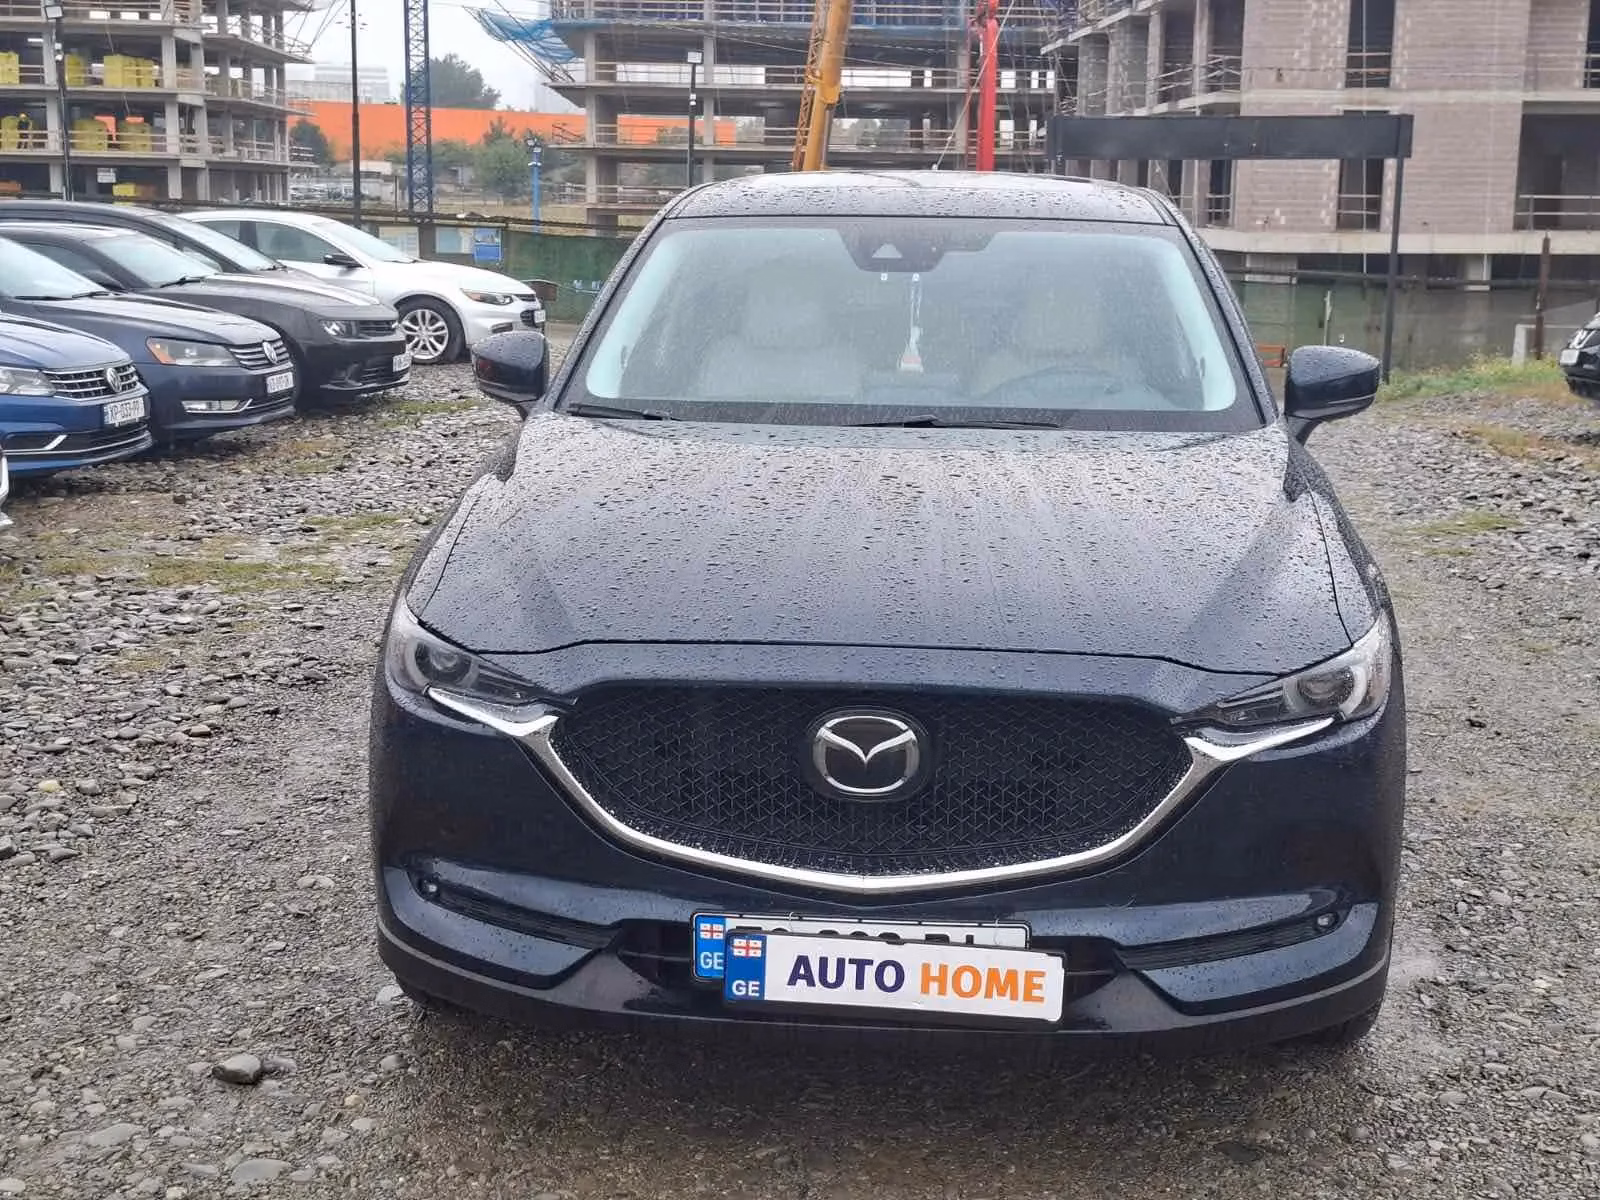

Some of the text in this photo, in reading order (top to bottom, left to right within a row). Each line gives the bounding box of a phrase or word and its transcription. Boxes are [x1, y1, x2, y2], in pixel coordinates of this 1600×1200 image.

[700, 951, 725, 970] GE
[731, 979, 761, 997] GE
[786, 954, 1047, 1003] AUTO HOME
